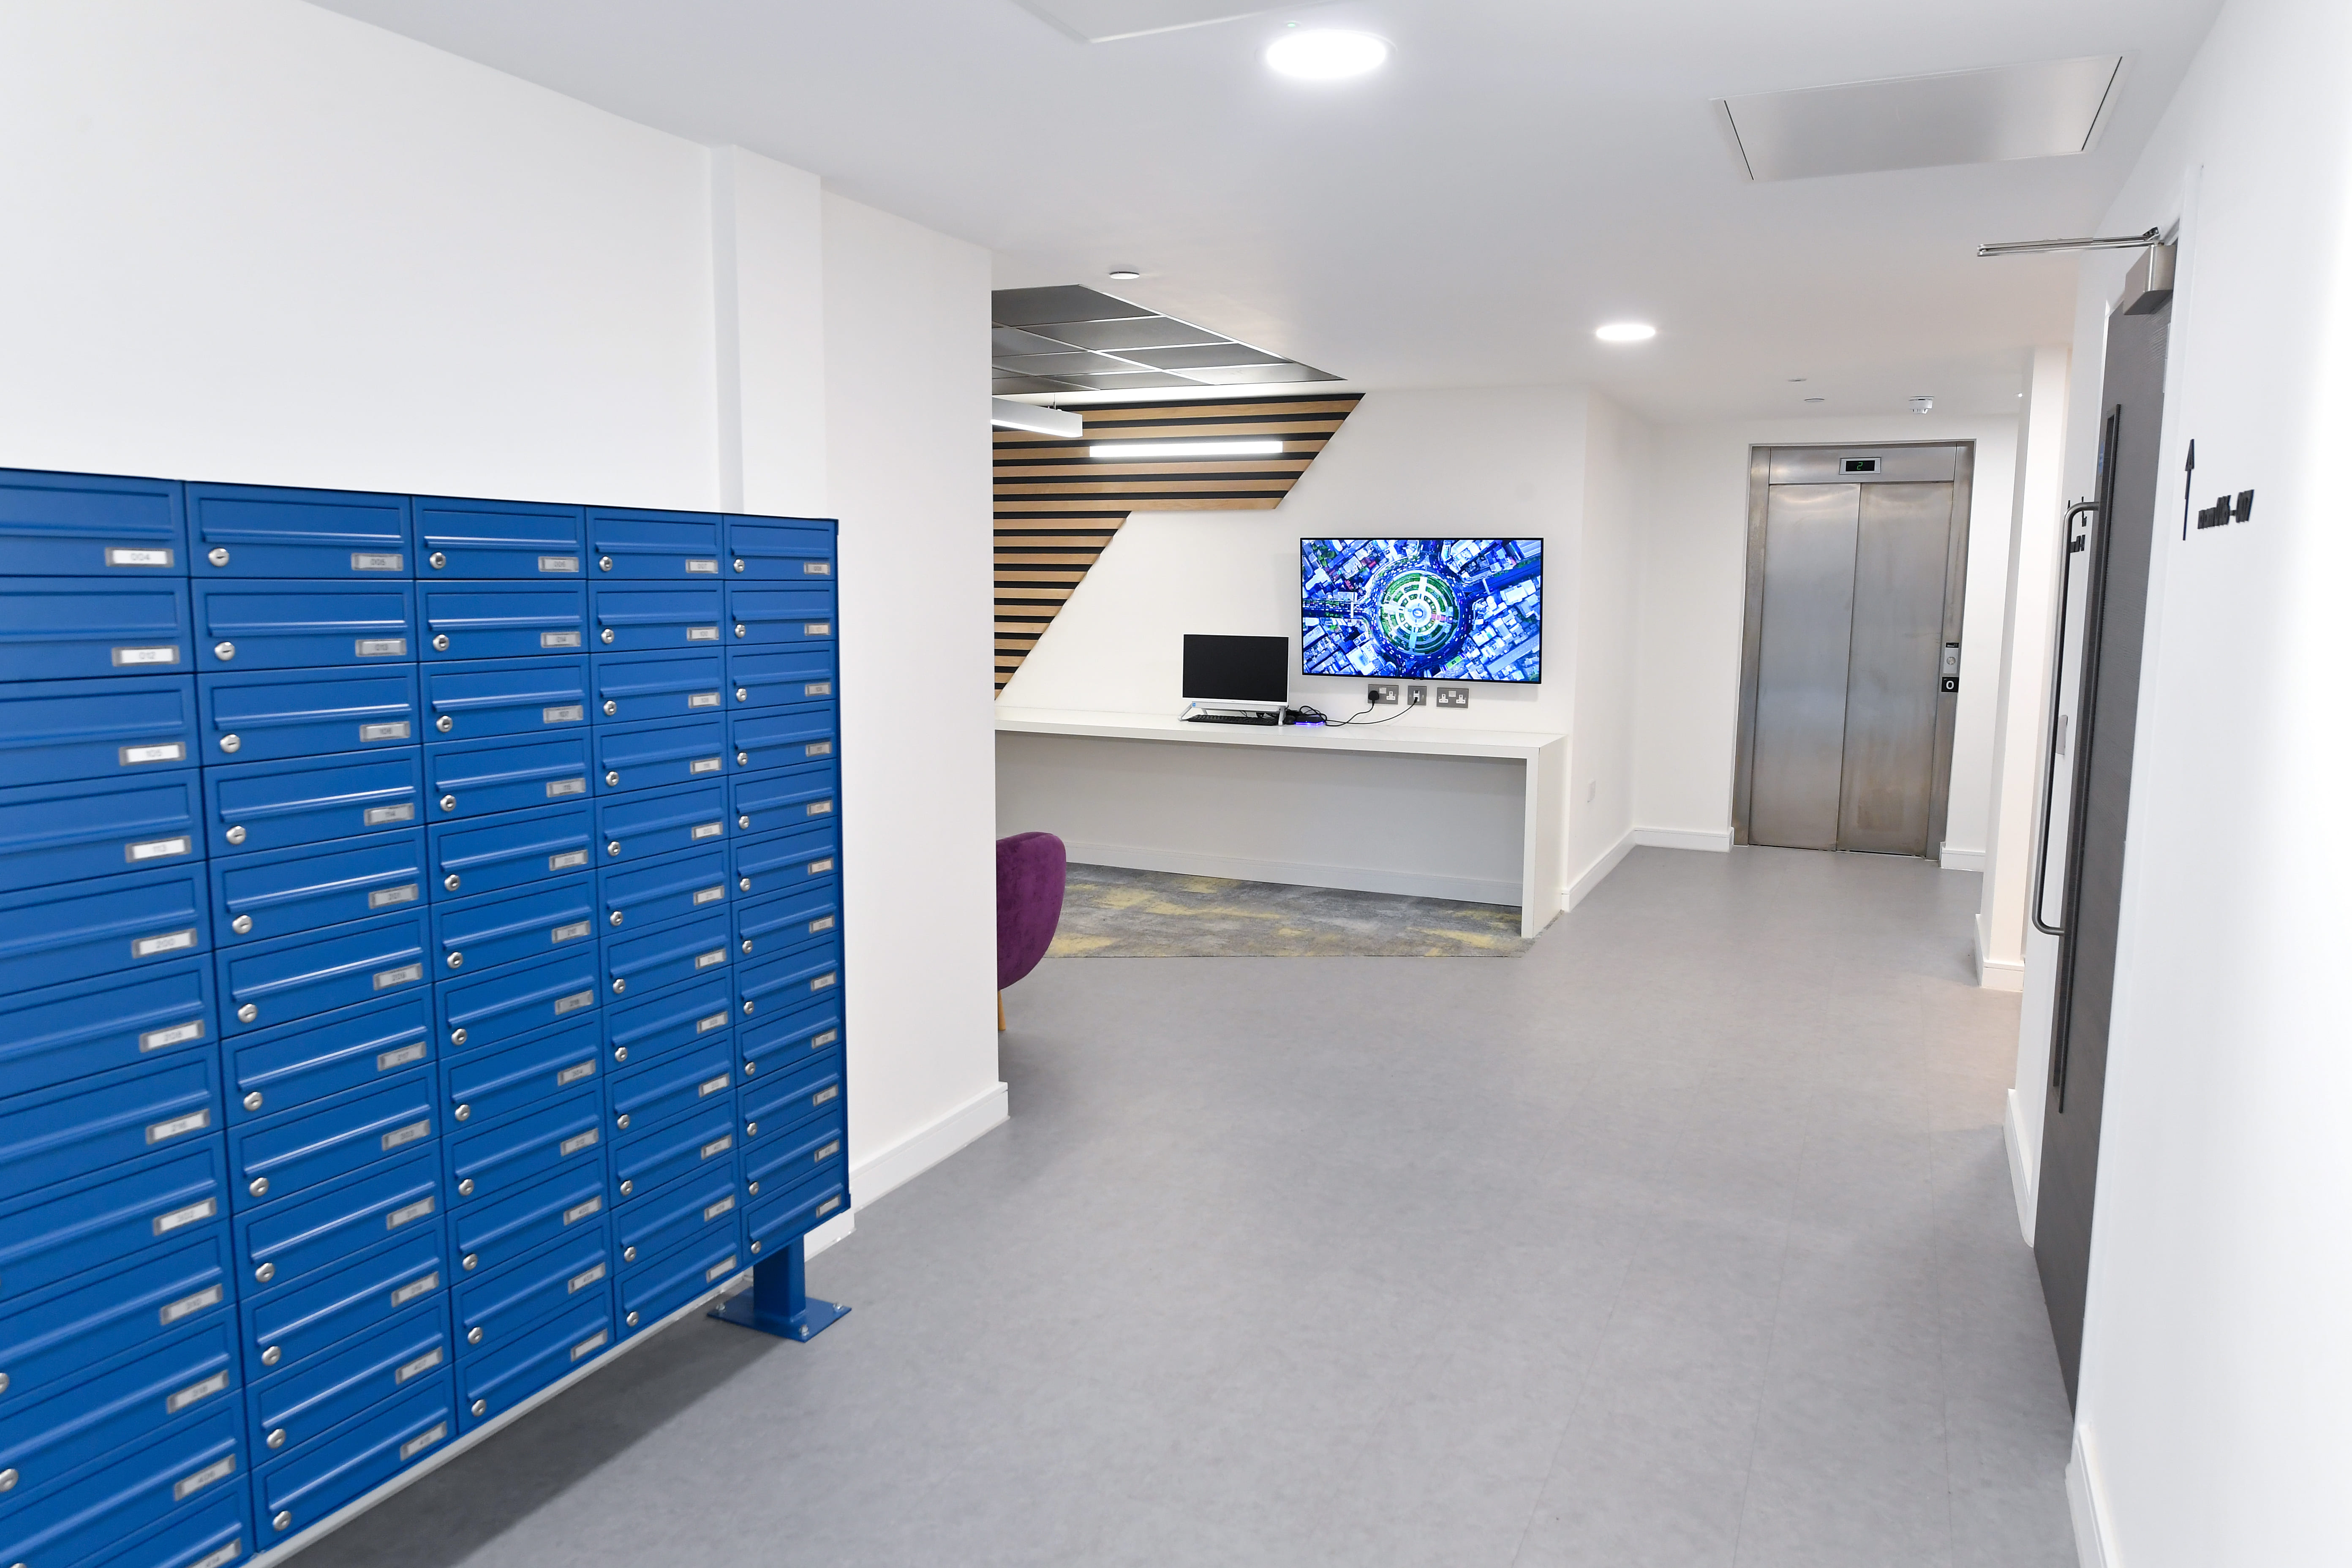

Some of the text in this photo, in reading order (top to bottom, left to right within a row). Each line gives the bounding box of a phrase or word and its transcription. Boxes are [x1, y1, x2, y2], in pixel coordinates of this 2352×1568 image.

[1857, 462, 1863, 470] 2
[131, 553, 150, 561] 004
[1946, 681, 1954, 689] 0
